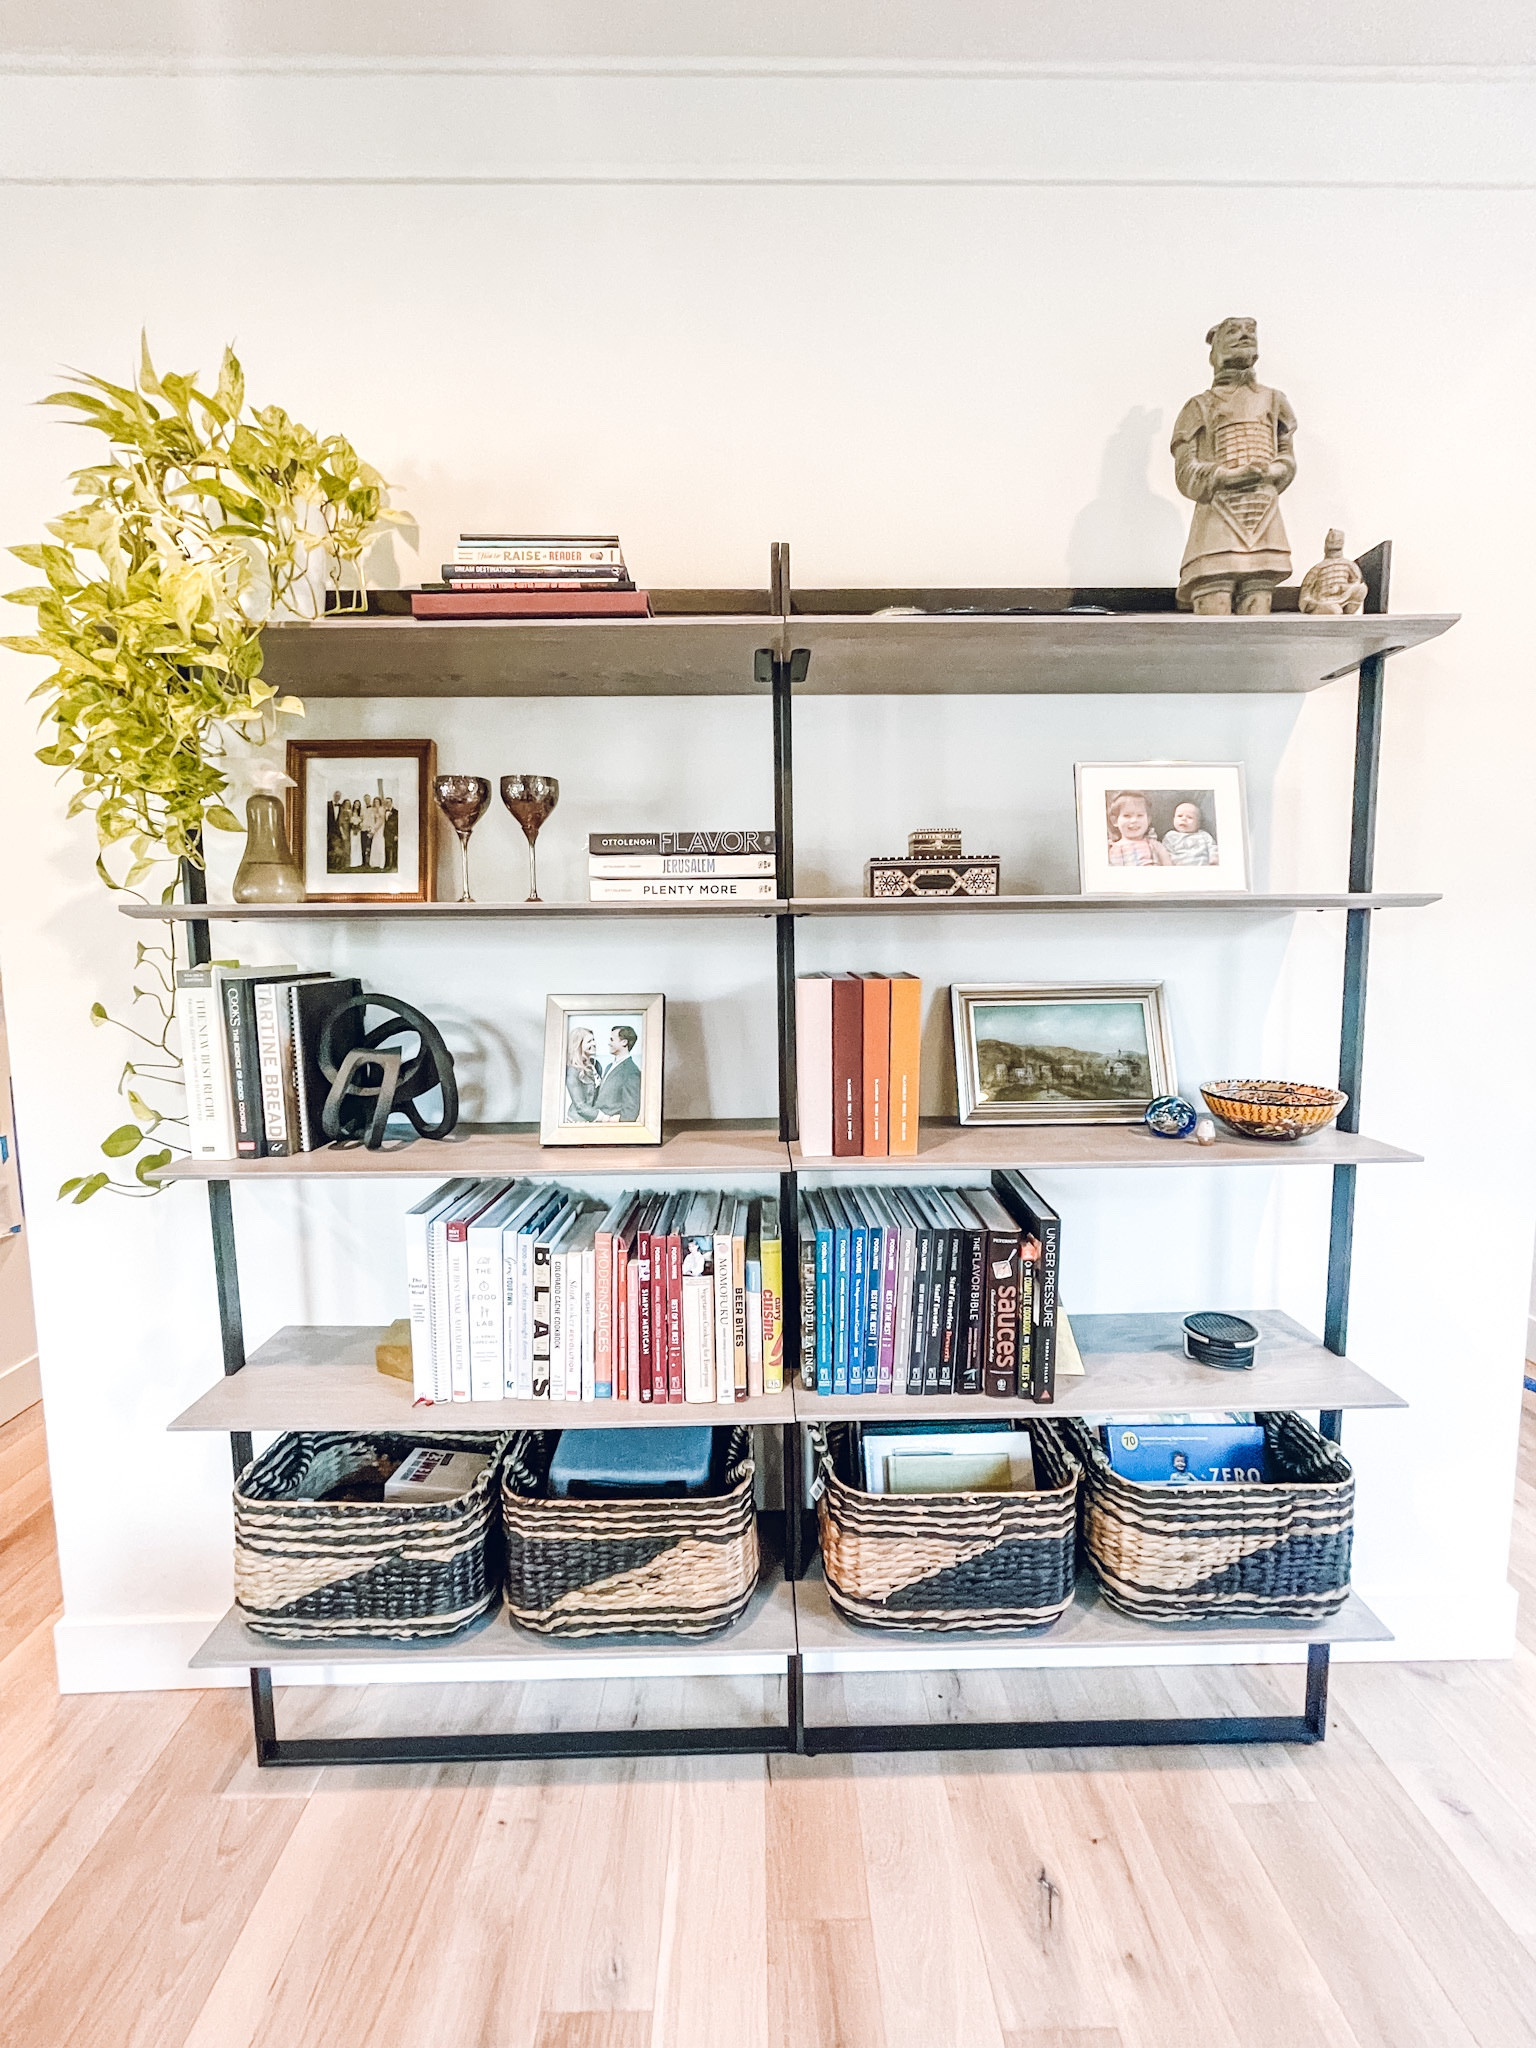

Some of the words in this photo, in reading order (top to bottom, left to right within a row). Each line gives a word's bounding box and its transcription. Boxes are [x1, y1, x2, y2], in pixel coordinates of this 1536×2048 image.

[503, 551, 541, 561] RAISE
[549, 550, 582, 561] READER
[602, 838, 656, 847] OTTOLENGHI
[660, 831, 762, 853] FLAVOR
[662, 858, 716, 874] JERUSALEM
[643, 886, 694, 895] PLENTY
[700, 885, 737, 894] MORE
[227, 988, 241, 1027] COOK'S
[199, 1024, 210, 1050] NEW
[257, 986, 278, 1067] TARTINE
[201, 1054, 213, 1081] BEST
[236, 1070, 243, 1079] OF
[203, 1083, 216, 1121] RECIPE
[237, 1080, 245, 1101] GOOD
[265, 1074, 283, 1138] BREAD
[973, 1237, 981, 1251] THE
[1045, 1227, 1057, 1268] UNDER
[506, 1277, 514, 1291] YOUR
[971, 1252, 982, 1291] FLAVOR
[506, 1292, 514, 1306] OWN
[718, 1258, 729, 1325] MOMOFUKU
[871, 1289, 879, 1303] BEST
[885, 1290, 893, 1304] BEST
[933, 1283, 942, 1303] Staff
[949, 1276, 957, 1296] Staff
[1023, 1277, 1032, 1305] COMPLETE
[1043, 1269, 1056, 1327] PRESSURE
[641, 1288, 649, 1316] SIMPLY
[671, 1299, 679, 1312] BEST
[735, 1288, 743, 1314] BEER
[805, 1285, 815, 1333] MINDFUL
[945, 1295, 956, 1330] Favorites
[969, 1292, 980, 1321] BIBLE
[532, 1246, 550, 1397] BLAIS
[762, 1289, 775, 1341] cuisine
[869, 1321, 878, 1335] BEST
[870, 1311, 878, 1321] THE
[884, 1312, 892, 1322] THE
[931, 1303, 941, 1338] Favorites
[996, 1285, 1017, 1368] sauces
[1023, 1306, 1032, 1335] COOKBOOK
[642, 1318, 650, 1355] MEXICAN
[672, 1331, 680, 1345] BEST
[702, 1321, 710, 1348] Cooking
[735, 1317, 744, 1347] BITES
[883, 1322, 892, 1336] BEST
[804, 1335, 814, 1373] EATING
[943, 1330, 953, 1363] Desserts
[1022, 1344, 1030, 1363] YOUNG
[703, 1359, 711, 1388] Everyone
[1021, 1363, 1030, 1381] CHEFS
[1123, 1436, 1136, 1447] 70
[1208, 1467, 1262, 1482] ZERO
